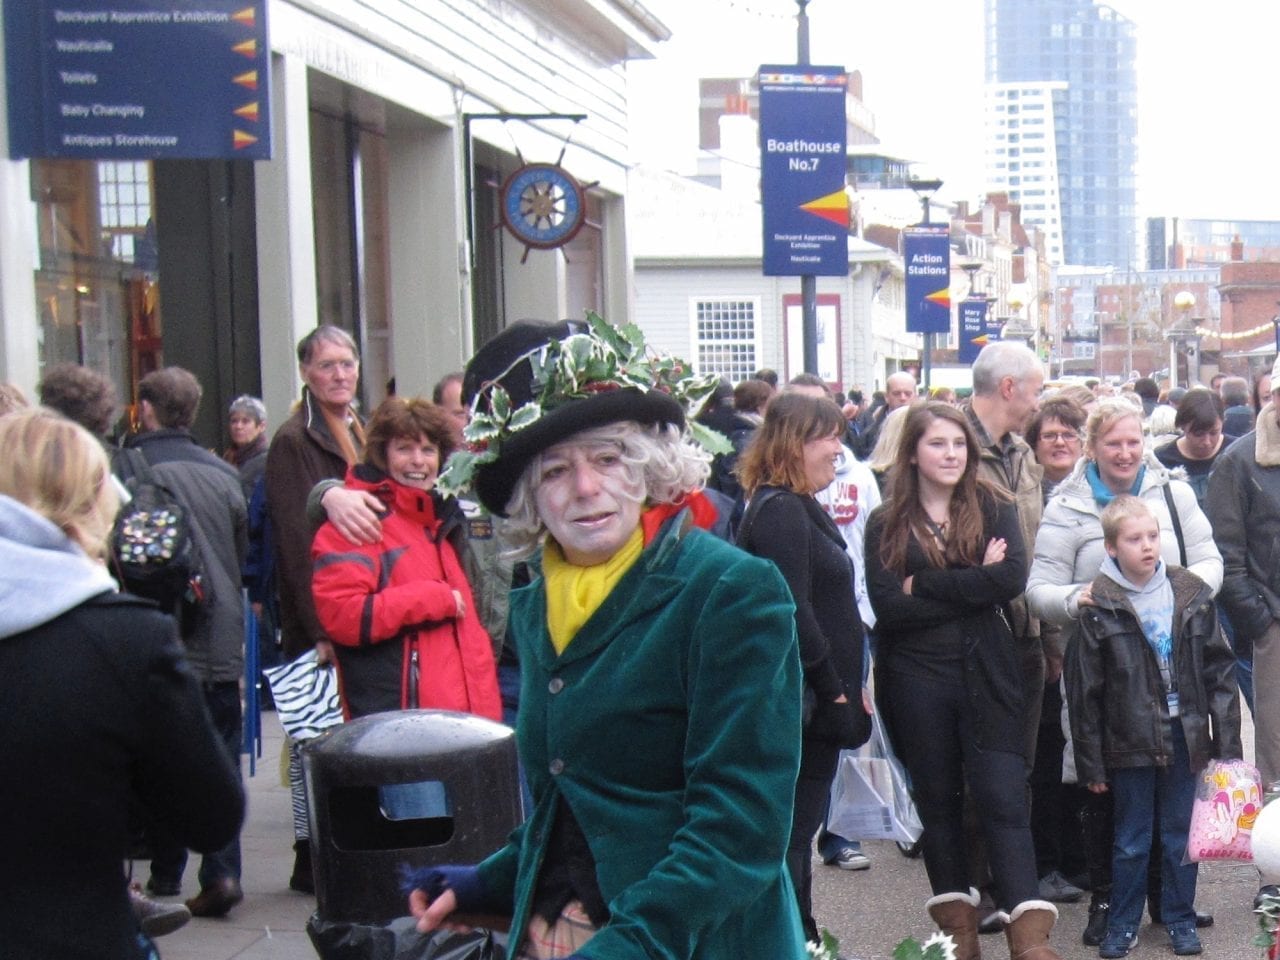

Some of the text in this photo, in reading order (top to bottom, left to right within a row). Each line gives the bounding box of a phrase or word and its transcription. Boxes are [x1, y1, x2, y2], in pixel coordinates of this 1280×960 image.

[55, 10, 229, 24] Dockyard Apprentice Exhibition
[61, 71, 98, 85] Toilets
[61, 103, 145, 119] Baby Changing
[62, 134, 178, 147] Antiques Storehouse
[767, 139, 841, 153] Boathouse
[789, 158, 820, 171] No.7
[911, 254, 943, 264] Action
[908, 265, 947, 275] Stations
[964, 309, 981, 317] Mary
[964, 324, 981, 332] Shop
